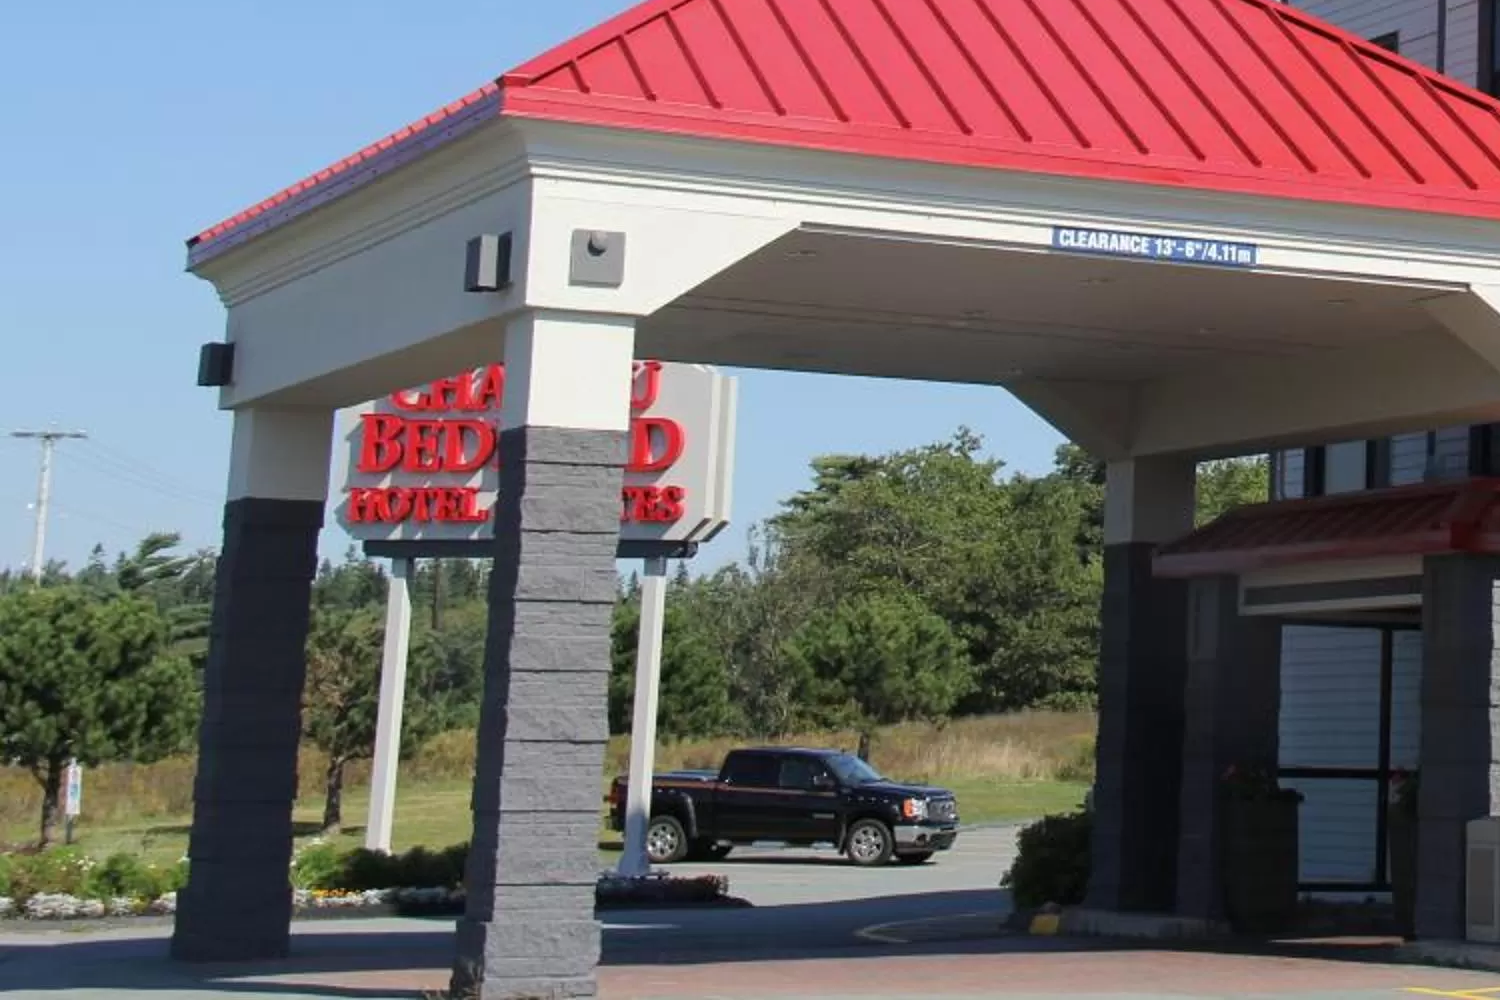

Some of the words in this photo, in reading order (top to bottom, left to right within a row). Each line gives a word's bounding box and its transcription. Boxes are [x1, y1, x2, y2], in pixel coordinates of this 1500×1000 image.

[1058, 229, 1149, 254] CLEARANCE
[357, 414, 685, 472] BEDD
[344, 487, 489, 523] HOTEL
